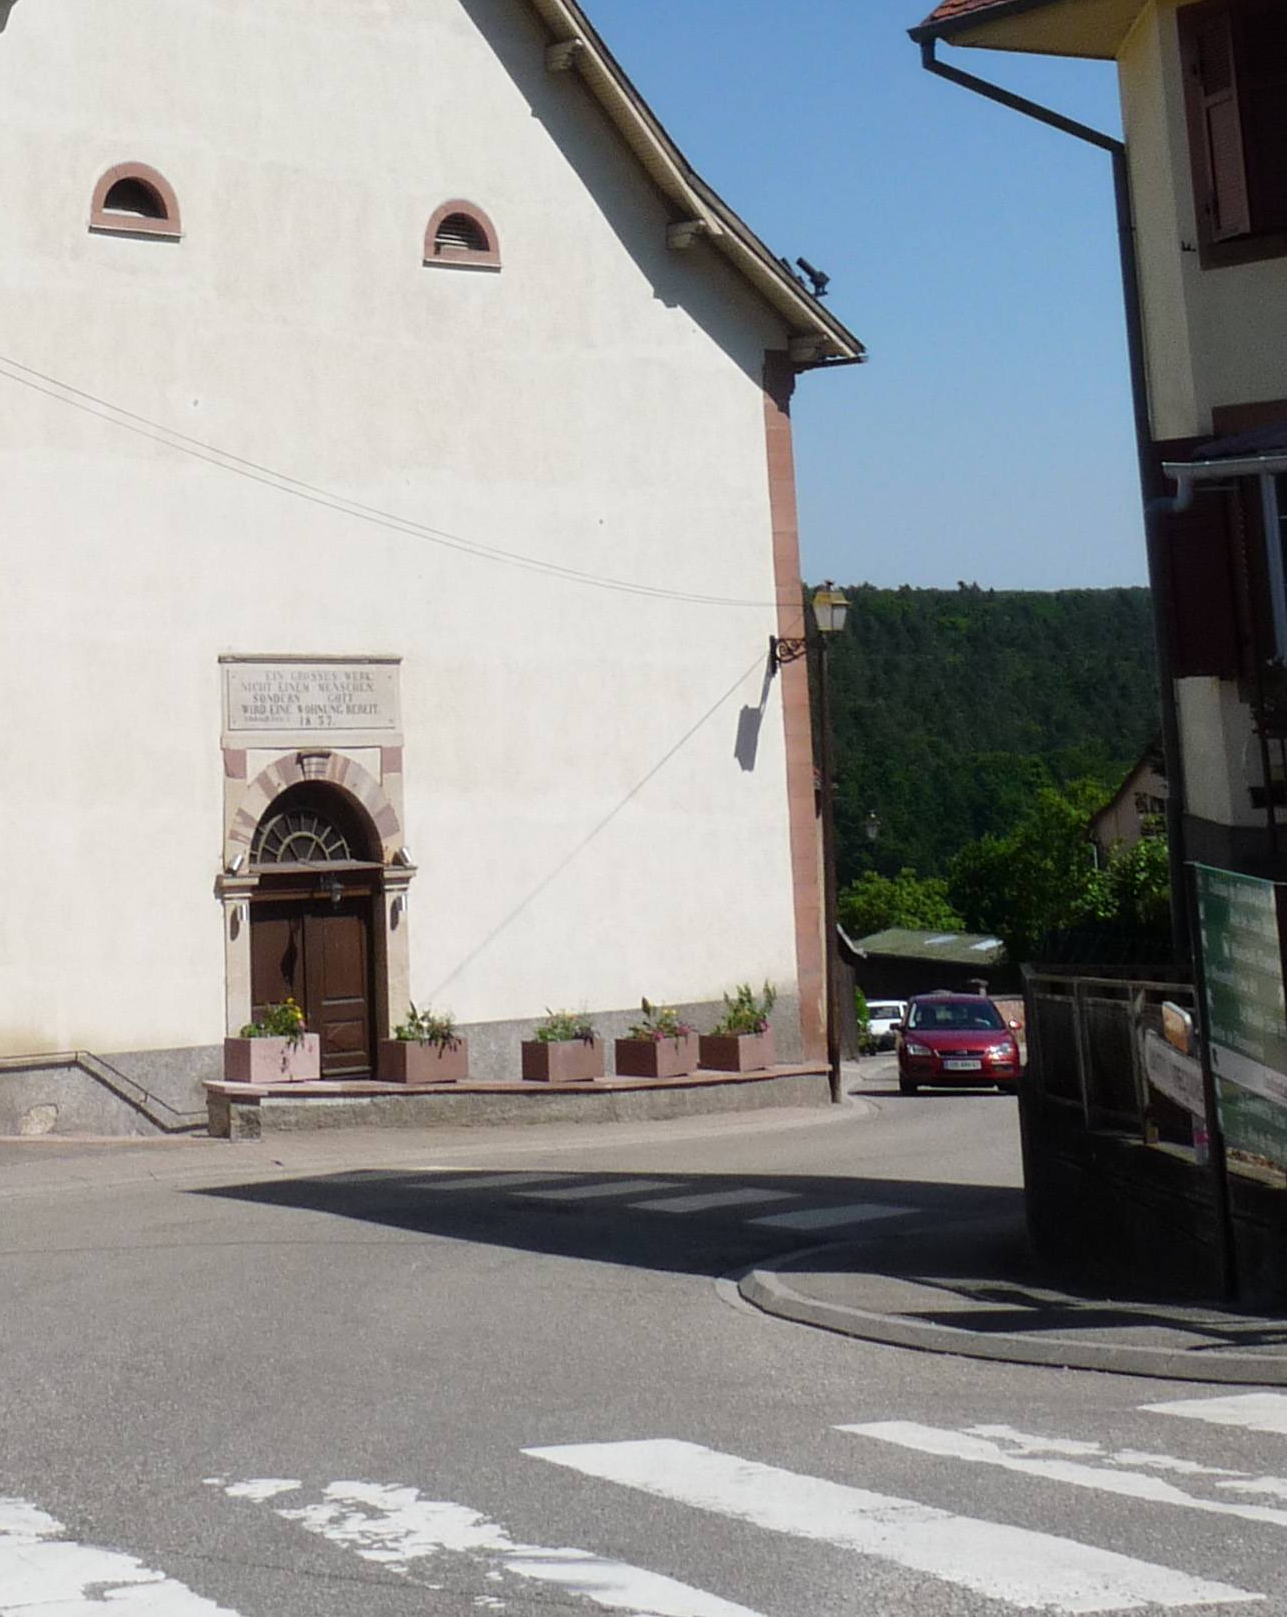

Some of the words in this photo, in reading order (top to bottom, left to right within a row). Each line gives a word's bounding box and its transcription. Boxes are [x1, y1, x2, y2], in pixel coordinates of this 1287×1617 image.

[265, 671, 284, 681] EIN
[241, 682, 272, 692] NICHT
[318, 682, 375, 693] MENSCHEN
[252, 693, 301, 704] SONDERN
[327, 693, 353, 704] GOTT
[241, 704, 267, 715] WIRD
[269, 704, 292, 715] EINE
[296, 704, 344, 715] WOHNUNG
